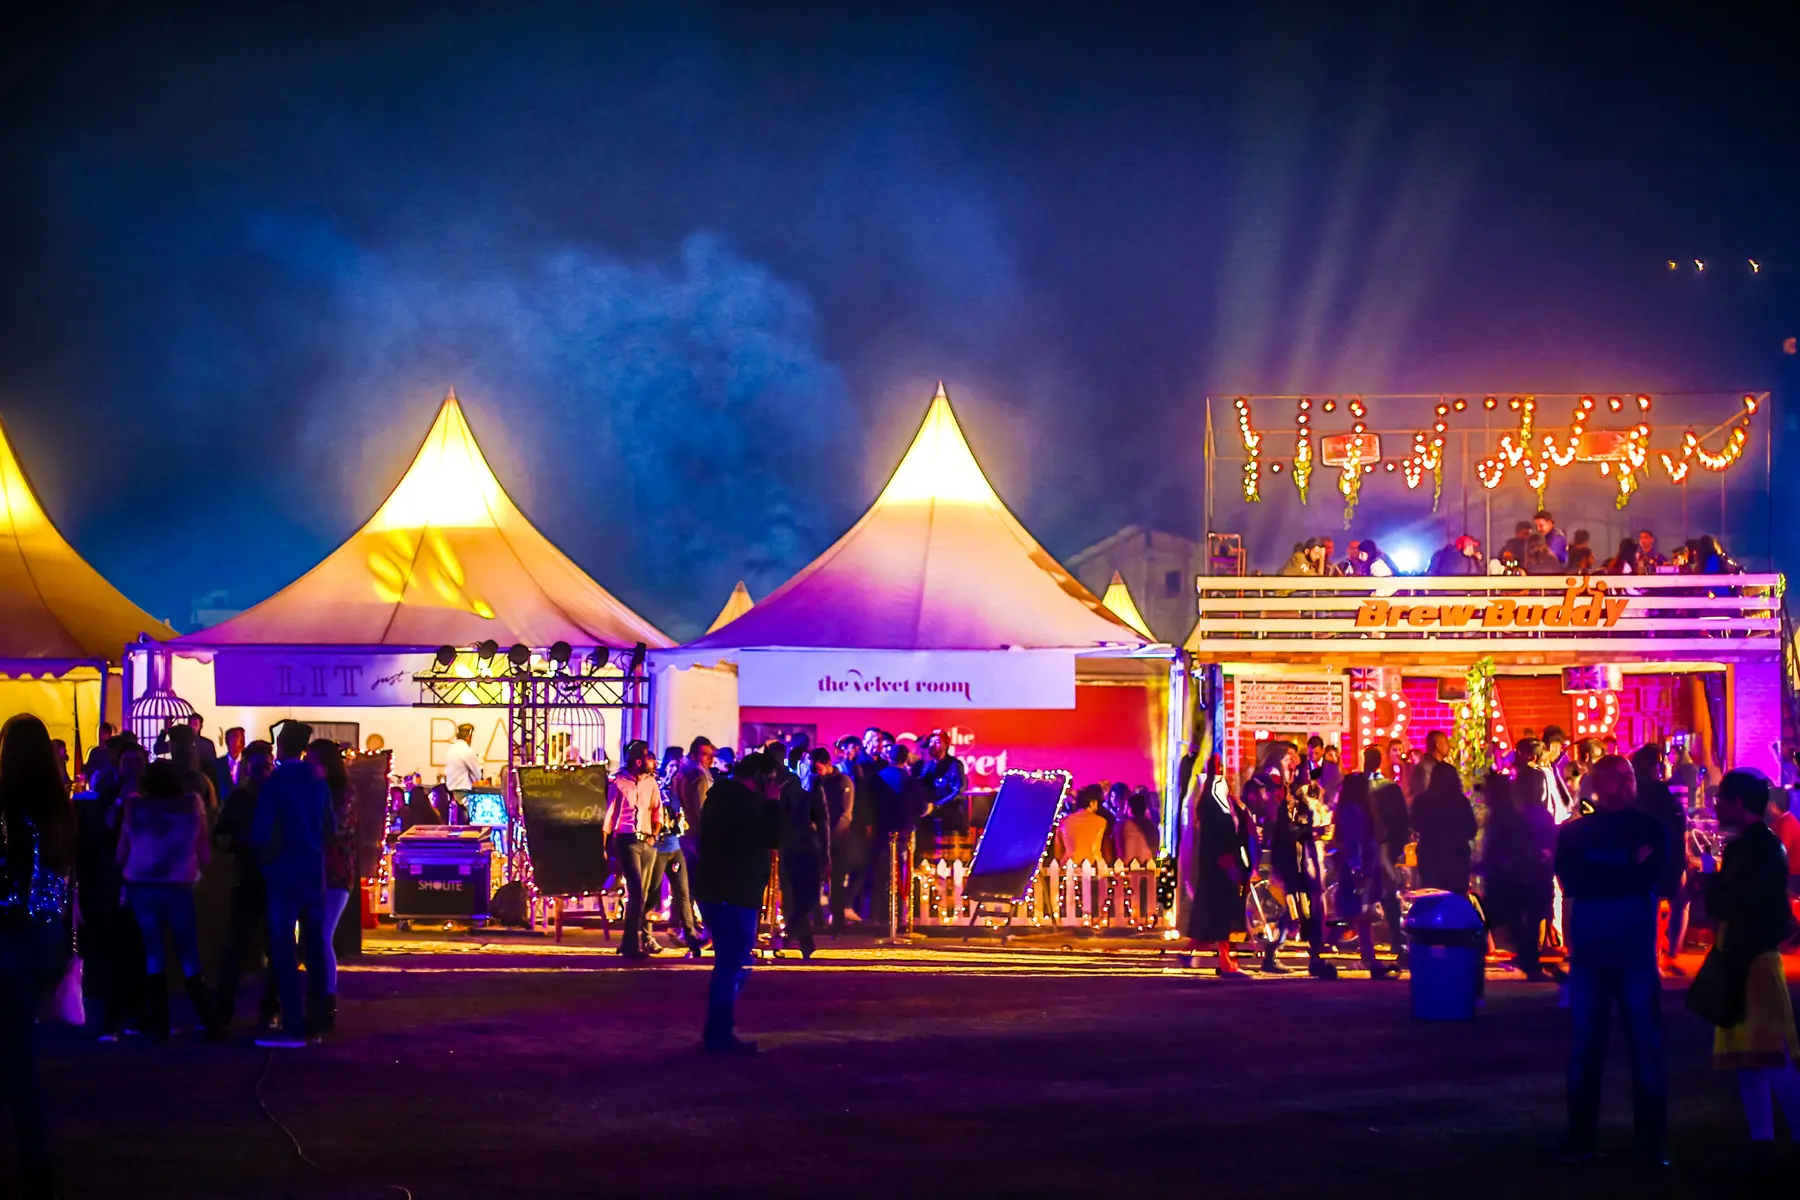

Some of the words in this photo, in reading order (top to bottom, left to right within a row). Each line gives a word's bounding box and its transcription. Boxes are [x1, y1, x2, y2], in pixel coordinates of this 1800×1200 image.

[1355, 600, 1476, 628] Brew
[1482, 577, 1630, 628] Buddy
[277, 665, 363, 697] LIT
[371, 670, 411, 691] just
[818, 675, 848, 692] the
[847, 669, 910, 692] velvet
[916, 681, 973, 702] room
